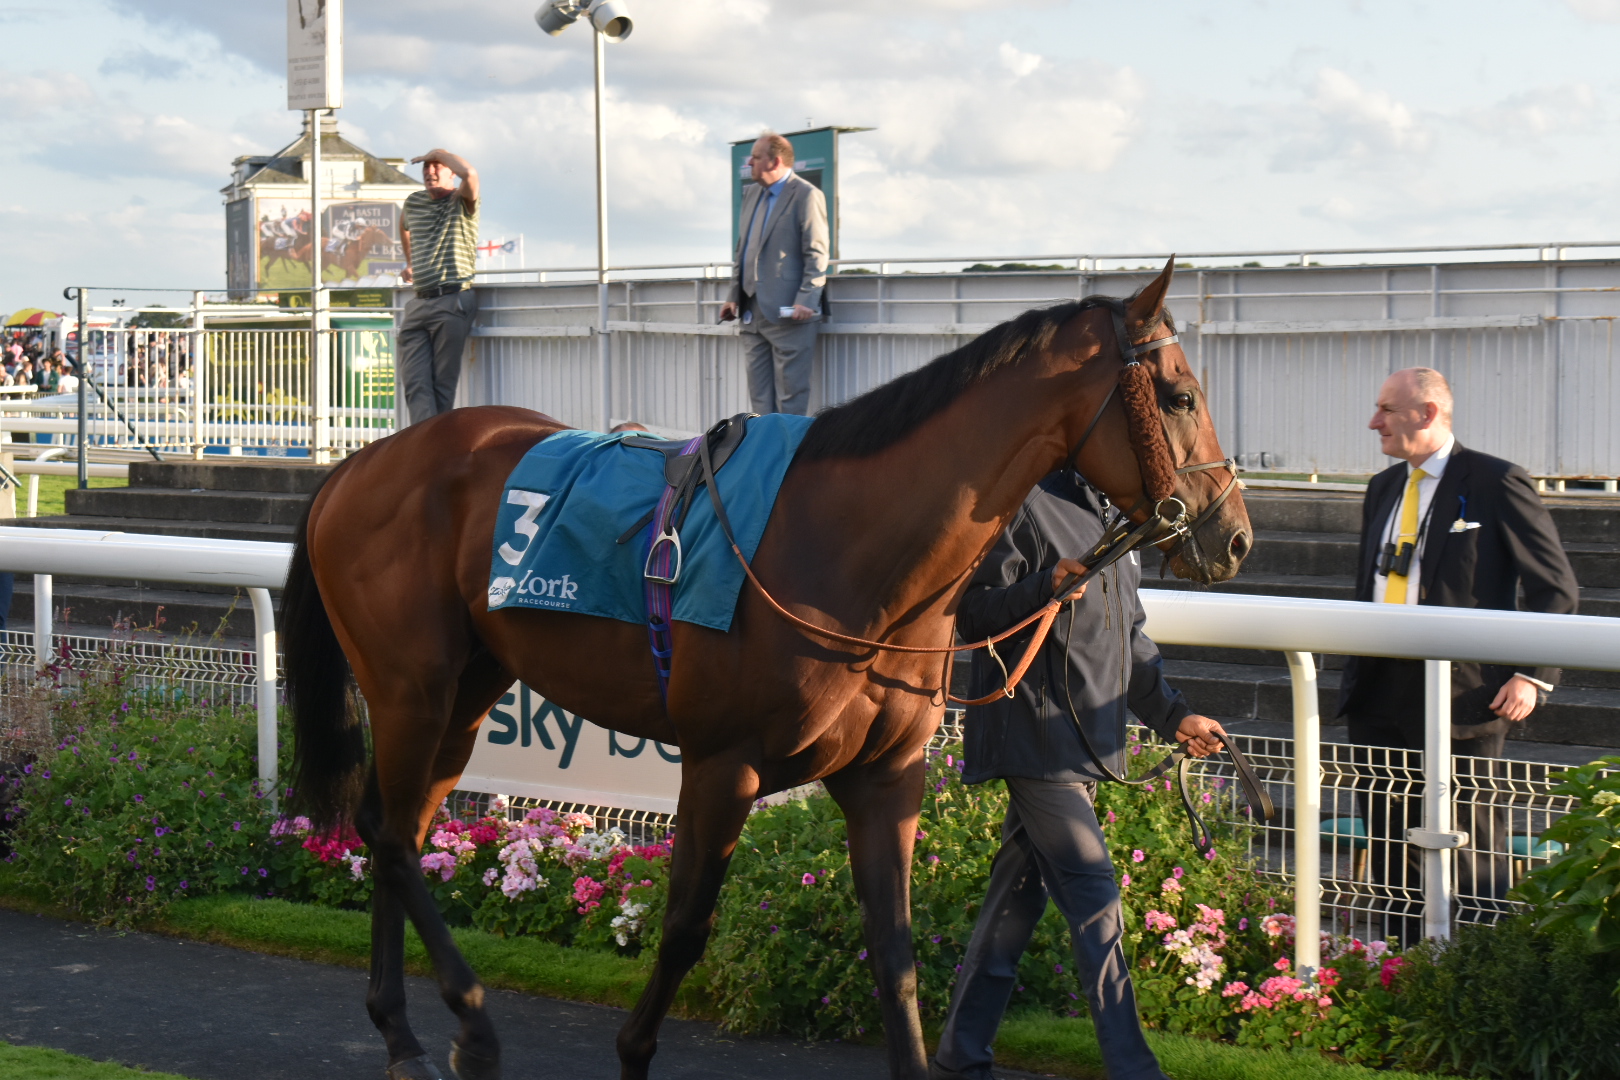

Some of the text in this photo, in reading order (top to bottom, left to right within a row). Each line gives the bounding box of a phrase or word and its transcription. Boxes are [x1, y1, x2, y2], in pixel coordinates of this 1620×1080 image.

[342, 208, 381, 217] A BASTI
[334, 218, 391, 227] EORLD
[382, 244, 403, 256] BAS
[498, 489, 551, 566] 3
[518, 597, 571, 609] RACECOURSE
[487, 680, 584, 769] sky
